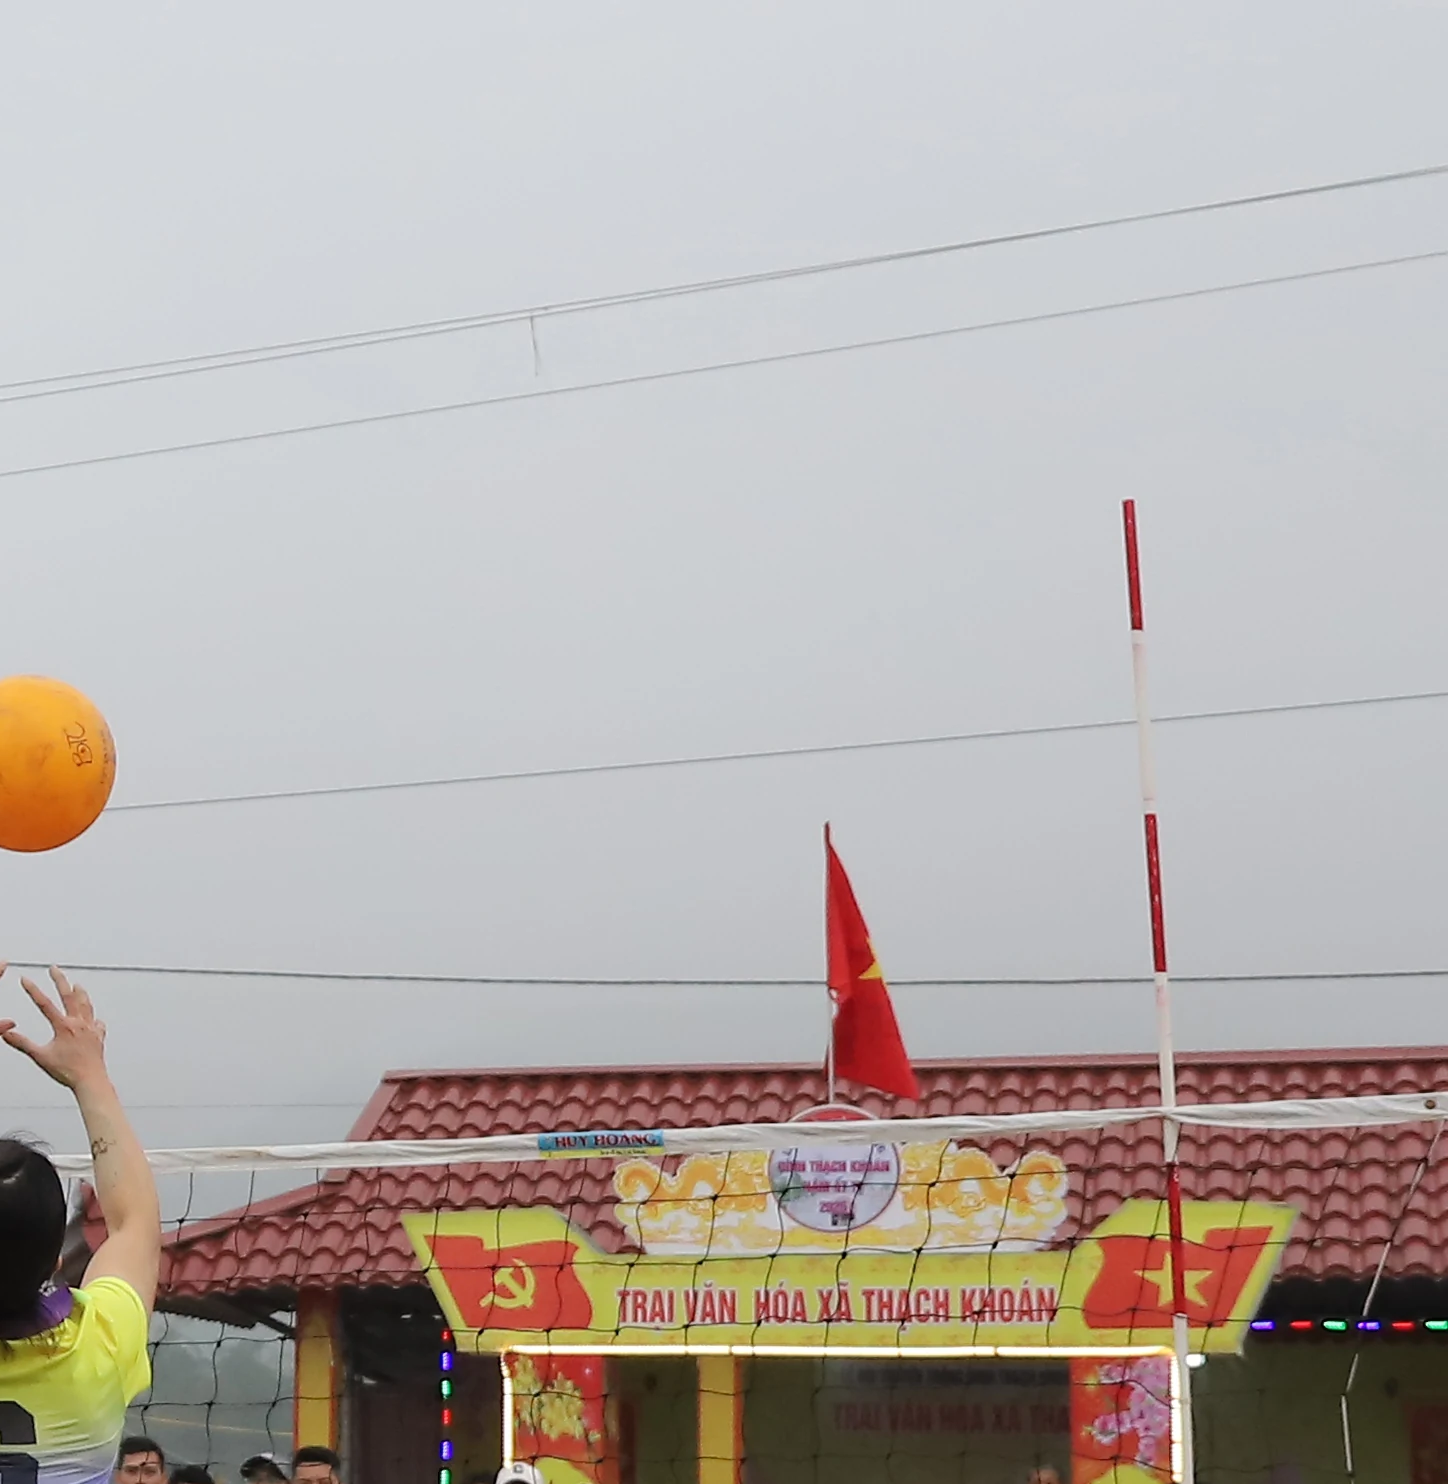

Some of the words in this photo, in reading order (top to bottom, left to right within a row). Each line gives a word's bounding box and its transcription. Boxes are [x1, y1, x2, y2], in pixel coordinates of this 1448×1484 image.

[554, 1135, 587, 1148] HUY
[617, 1289, 675, 1330] TRẠI
[683, 1282, 736, 1323] VĂN
[755, 1281, 807, 1324] HÓA
[818, 1282, 852, 1323] XÃ
[862, 1288, 949, 1331] THẠCH
[960, 1280, 1056, 1323] KHOÁN
